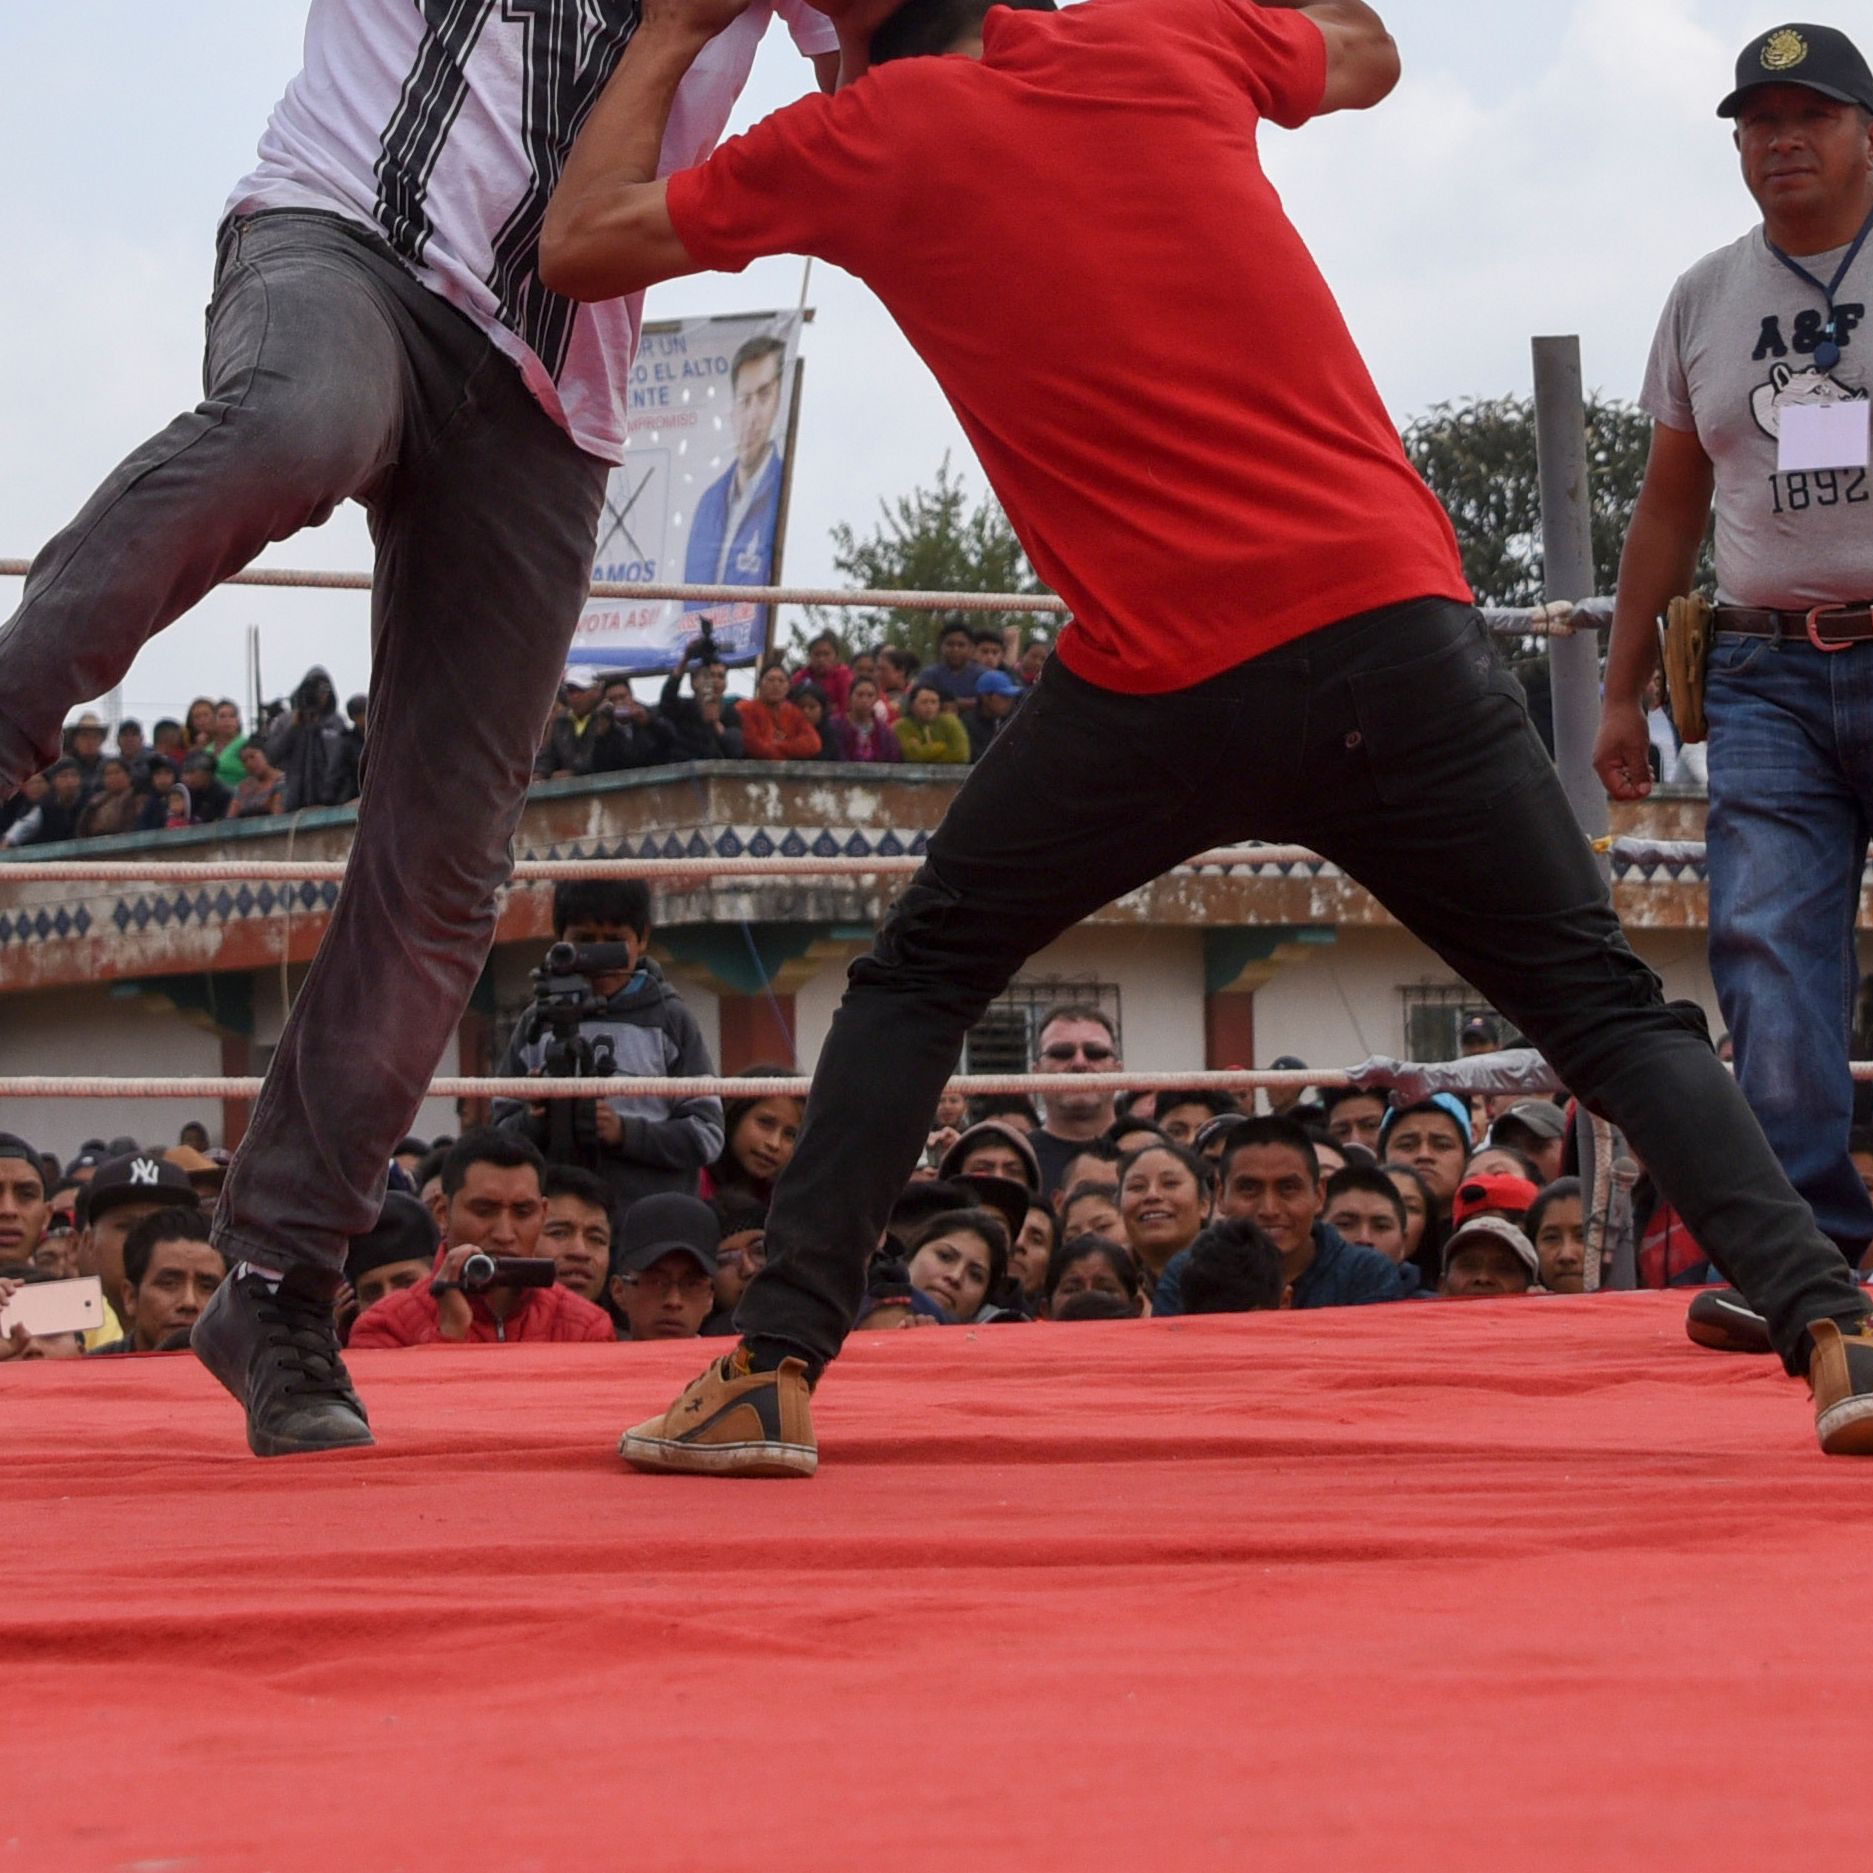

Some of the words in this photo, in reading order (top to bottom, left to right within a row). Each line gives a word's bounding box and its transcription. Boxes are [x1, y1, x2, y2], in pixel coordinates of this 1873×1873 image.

[1752, 303, 1865, 360] A&F
[660, 335, 688, 356] UN
[655, 362, 677, 382] EL
[682, 356, 729, 378] ALTO
[630, 386, 670, 409] NTE
[628, 412, 698, 433] MPROMISO
[1767, 467, 1870, 515] 1892
[592, 560, 656, 583] AMOS
[129, 1156, 160, 1186] NY
